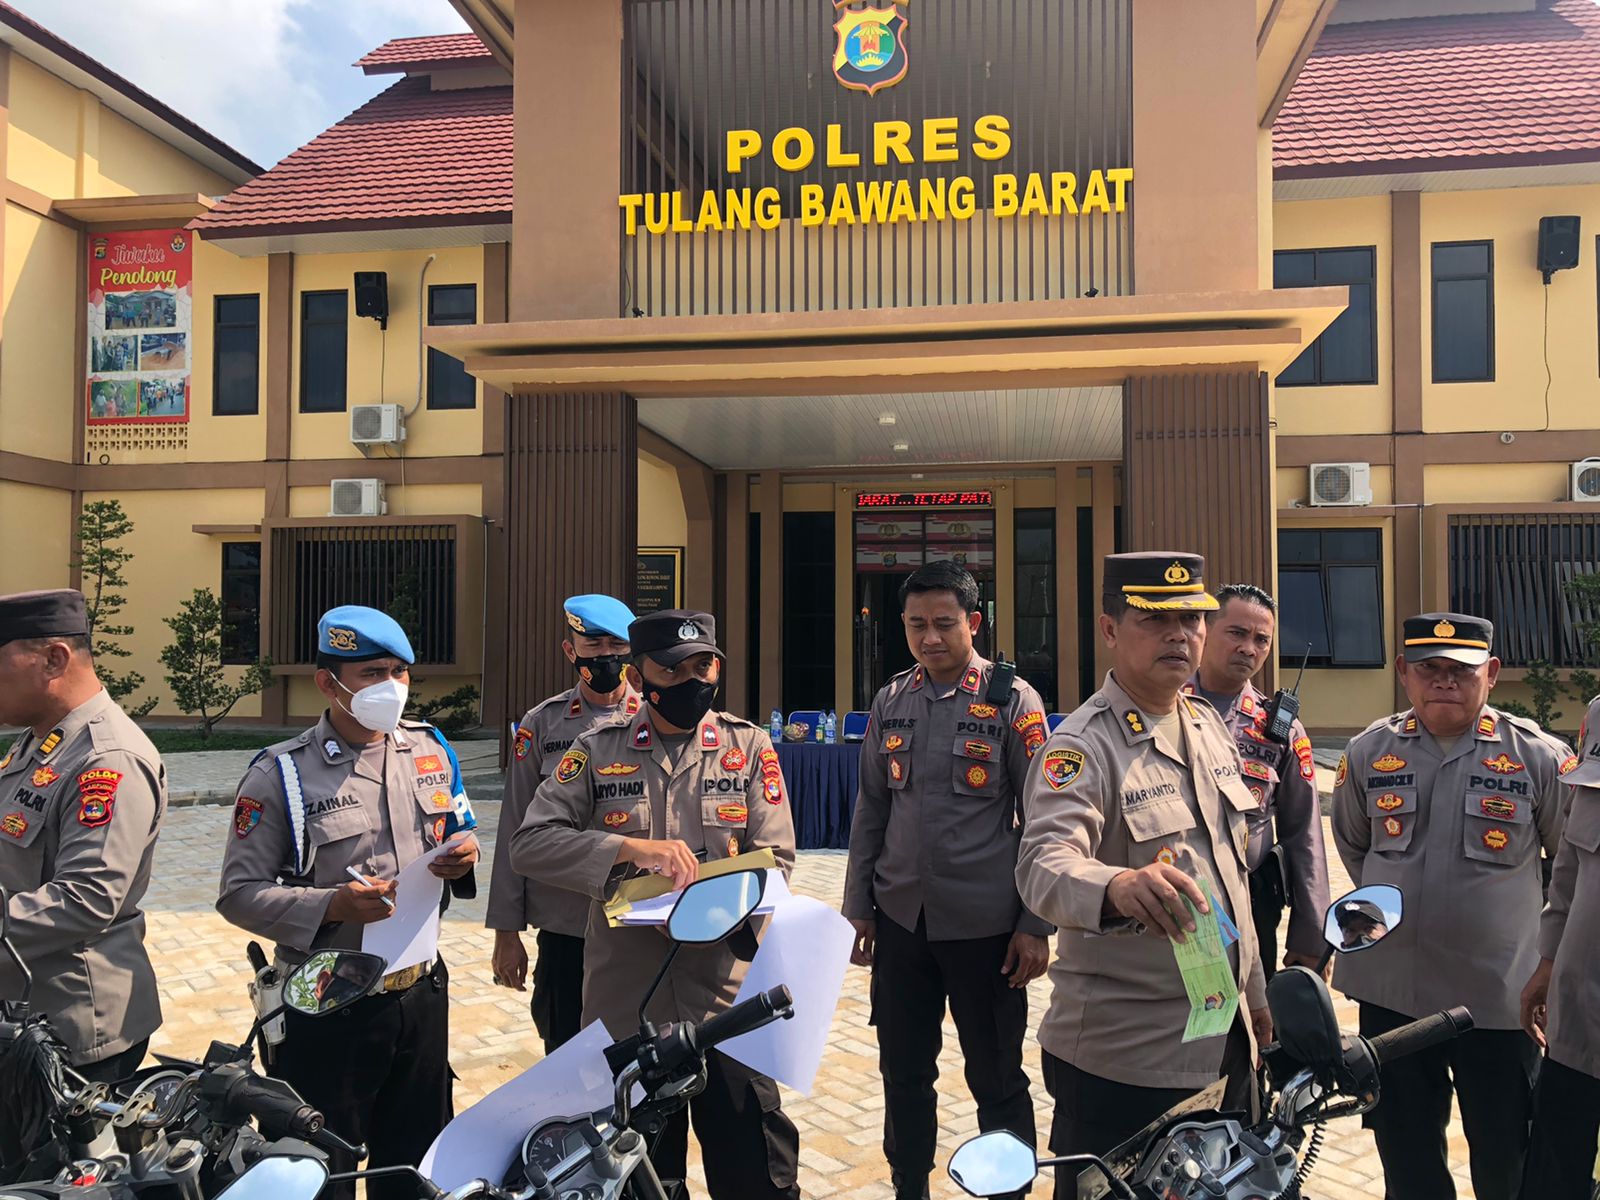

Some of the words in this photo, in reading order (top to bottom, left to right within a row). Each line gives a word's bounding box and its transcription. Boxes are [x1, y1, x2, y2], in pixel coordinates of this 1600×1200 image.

[726, 114, 1013, 173] POLRES
[618, 186, 781, 236] TULANG
[801, 176, 976, 227] BAWANG
[993, 167, 1134, 217] BARAT
[100, 265, 177, 288] Penolong
[957, 721, 1003, 737] POLRI
[1237, 742, 1277, 764] POLRI
[81, 770, 118, 783] POLDA
[417, 773, 449, 788] POLRI
[1470, 775, 1528, 796] POLRI
[618, 780, 644, 797] HADI
[1125, 783, 1176, 805] MARYANTO
[14, 787, 47, 813] POLRI
[306, 793, 359, 817] ZAINAL
